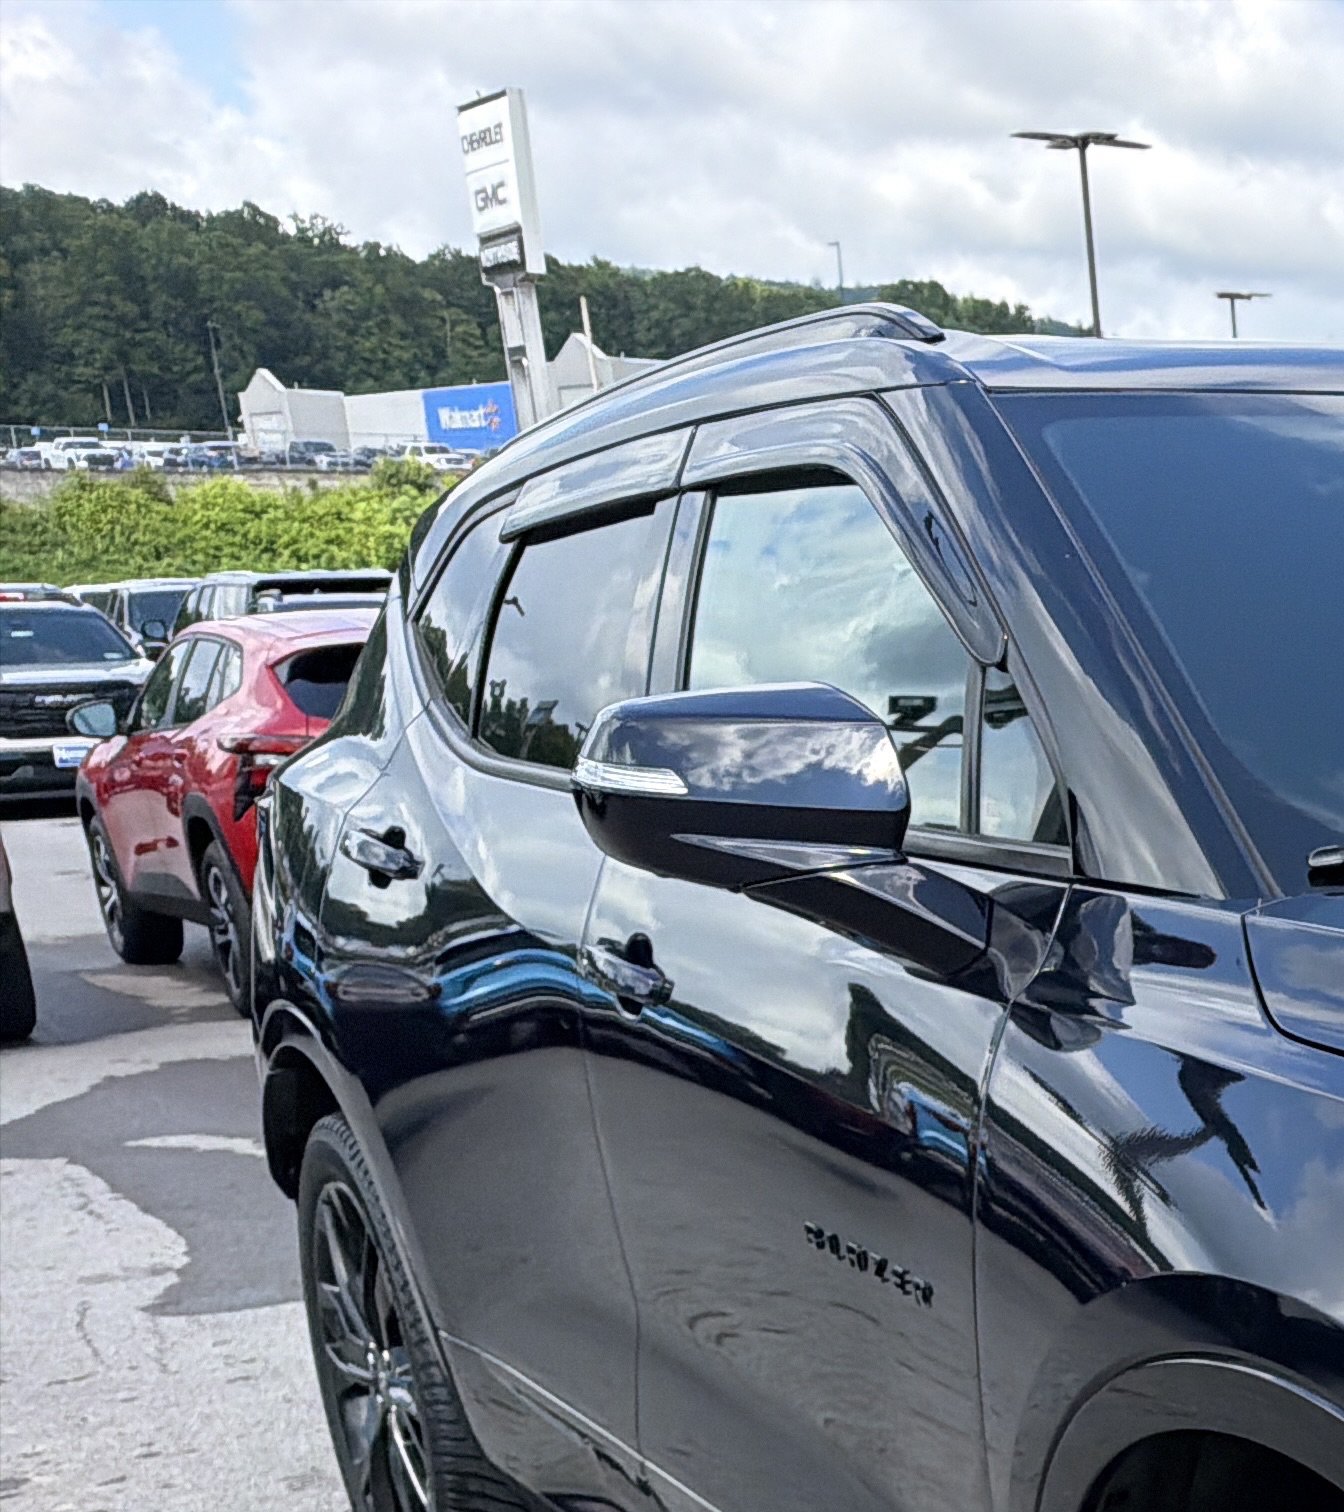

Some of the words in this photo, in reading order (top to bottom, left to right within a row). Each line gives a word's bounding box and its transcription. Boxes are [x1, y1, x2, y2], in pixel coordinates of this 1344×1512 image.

[474, 181, 507, 212] GMC
[437, 404, 487, 430] Walmart
[803, 1220, 935, 1308] BLAZER
